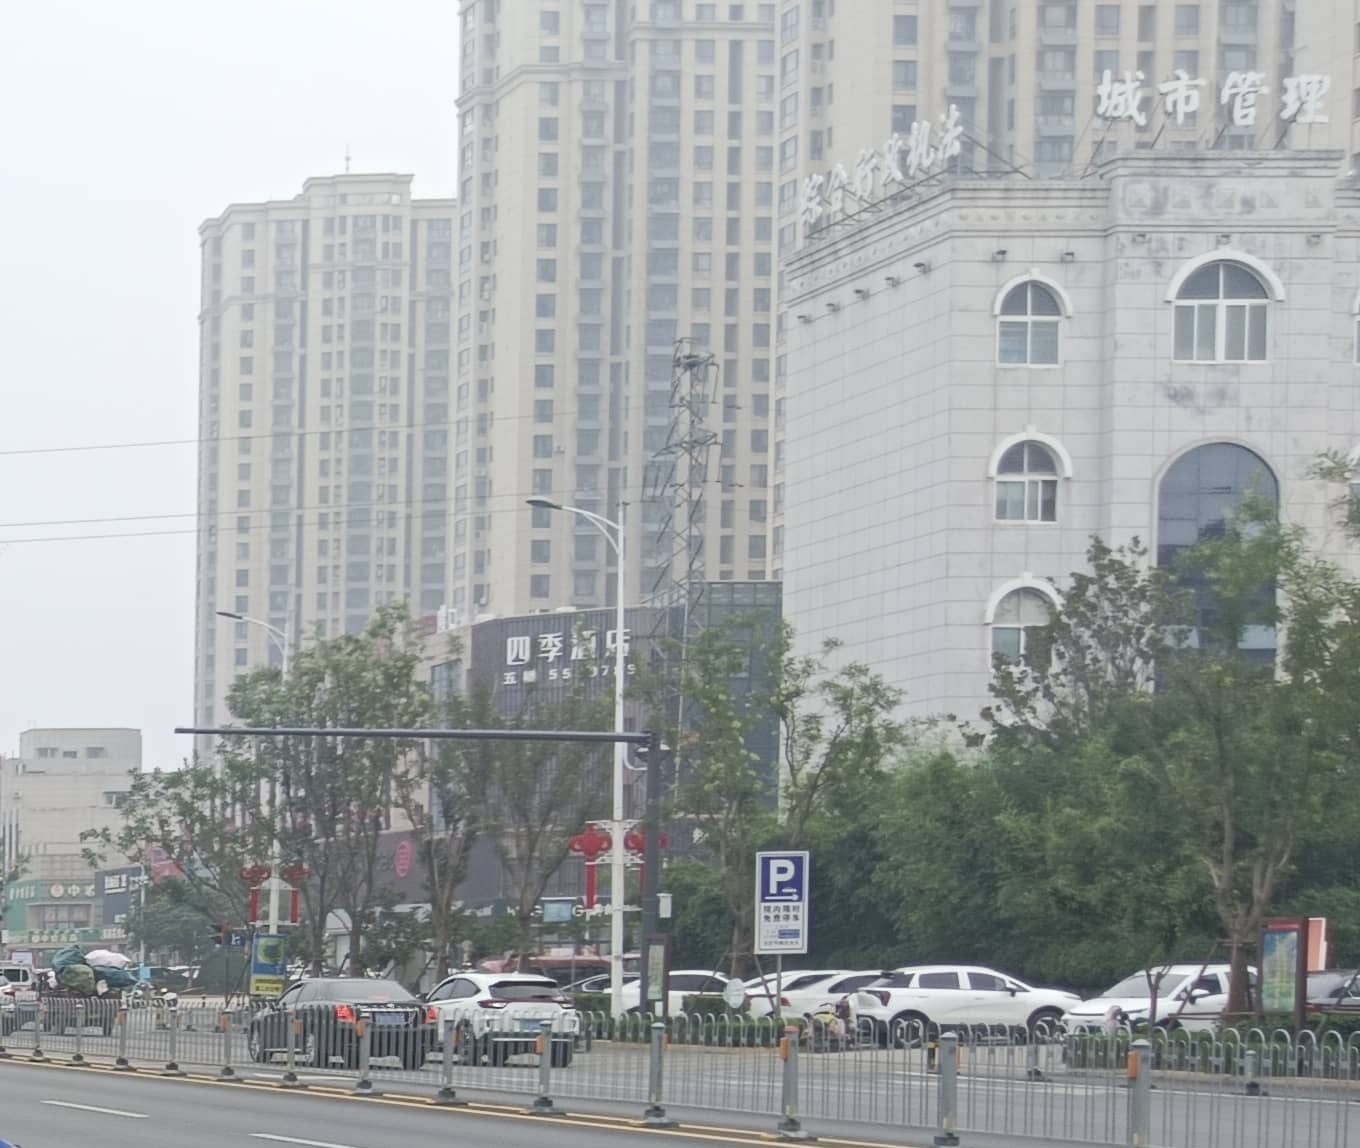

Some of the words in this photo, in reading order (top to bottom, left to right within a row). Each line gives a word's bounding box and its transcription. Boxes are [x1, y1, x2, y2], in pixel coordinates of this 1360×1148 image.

[1096, 68, 1332, 126] 城市管理
[506, 628, 631, 666] 四季酒店
[769, 859, 795, 895] P
